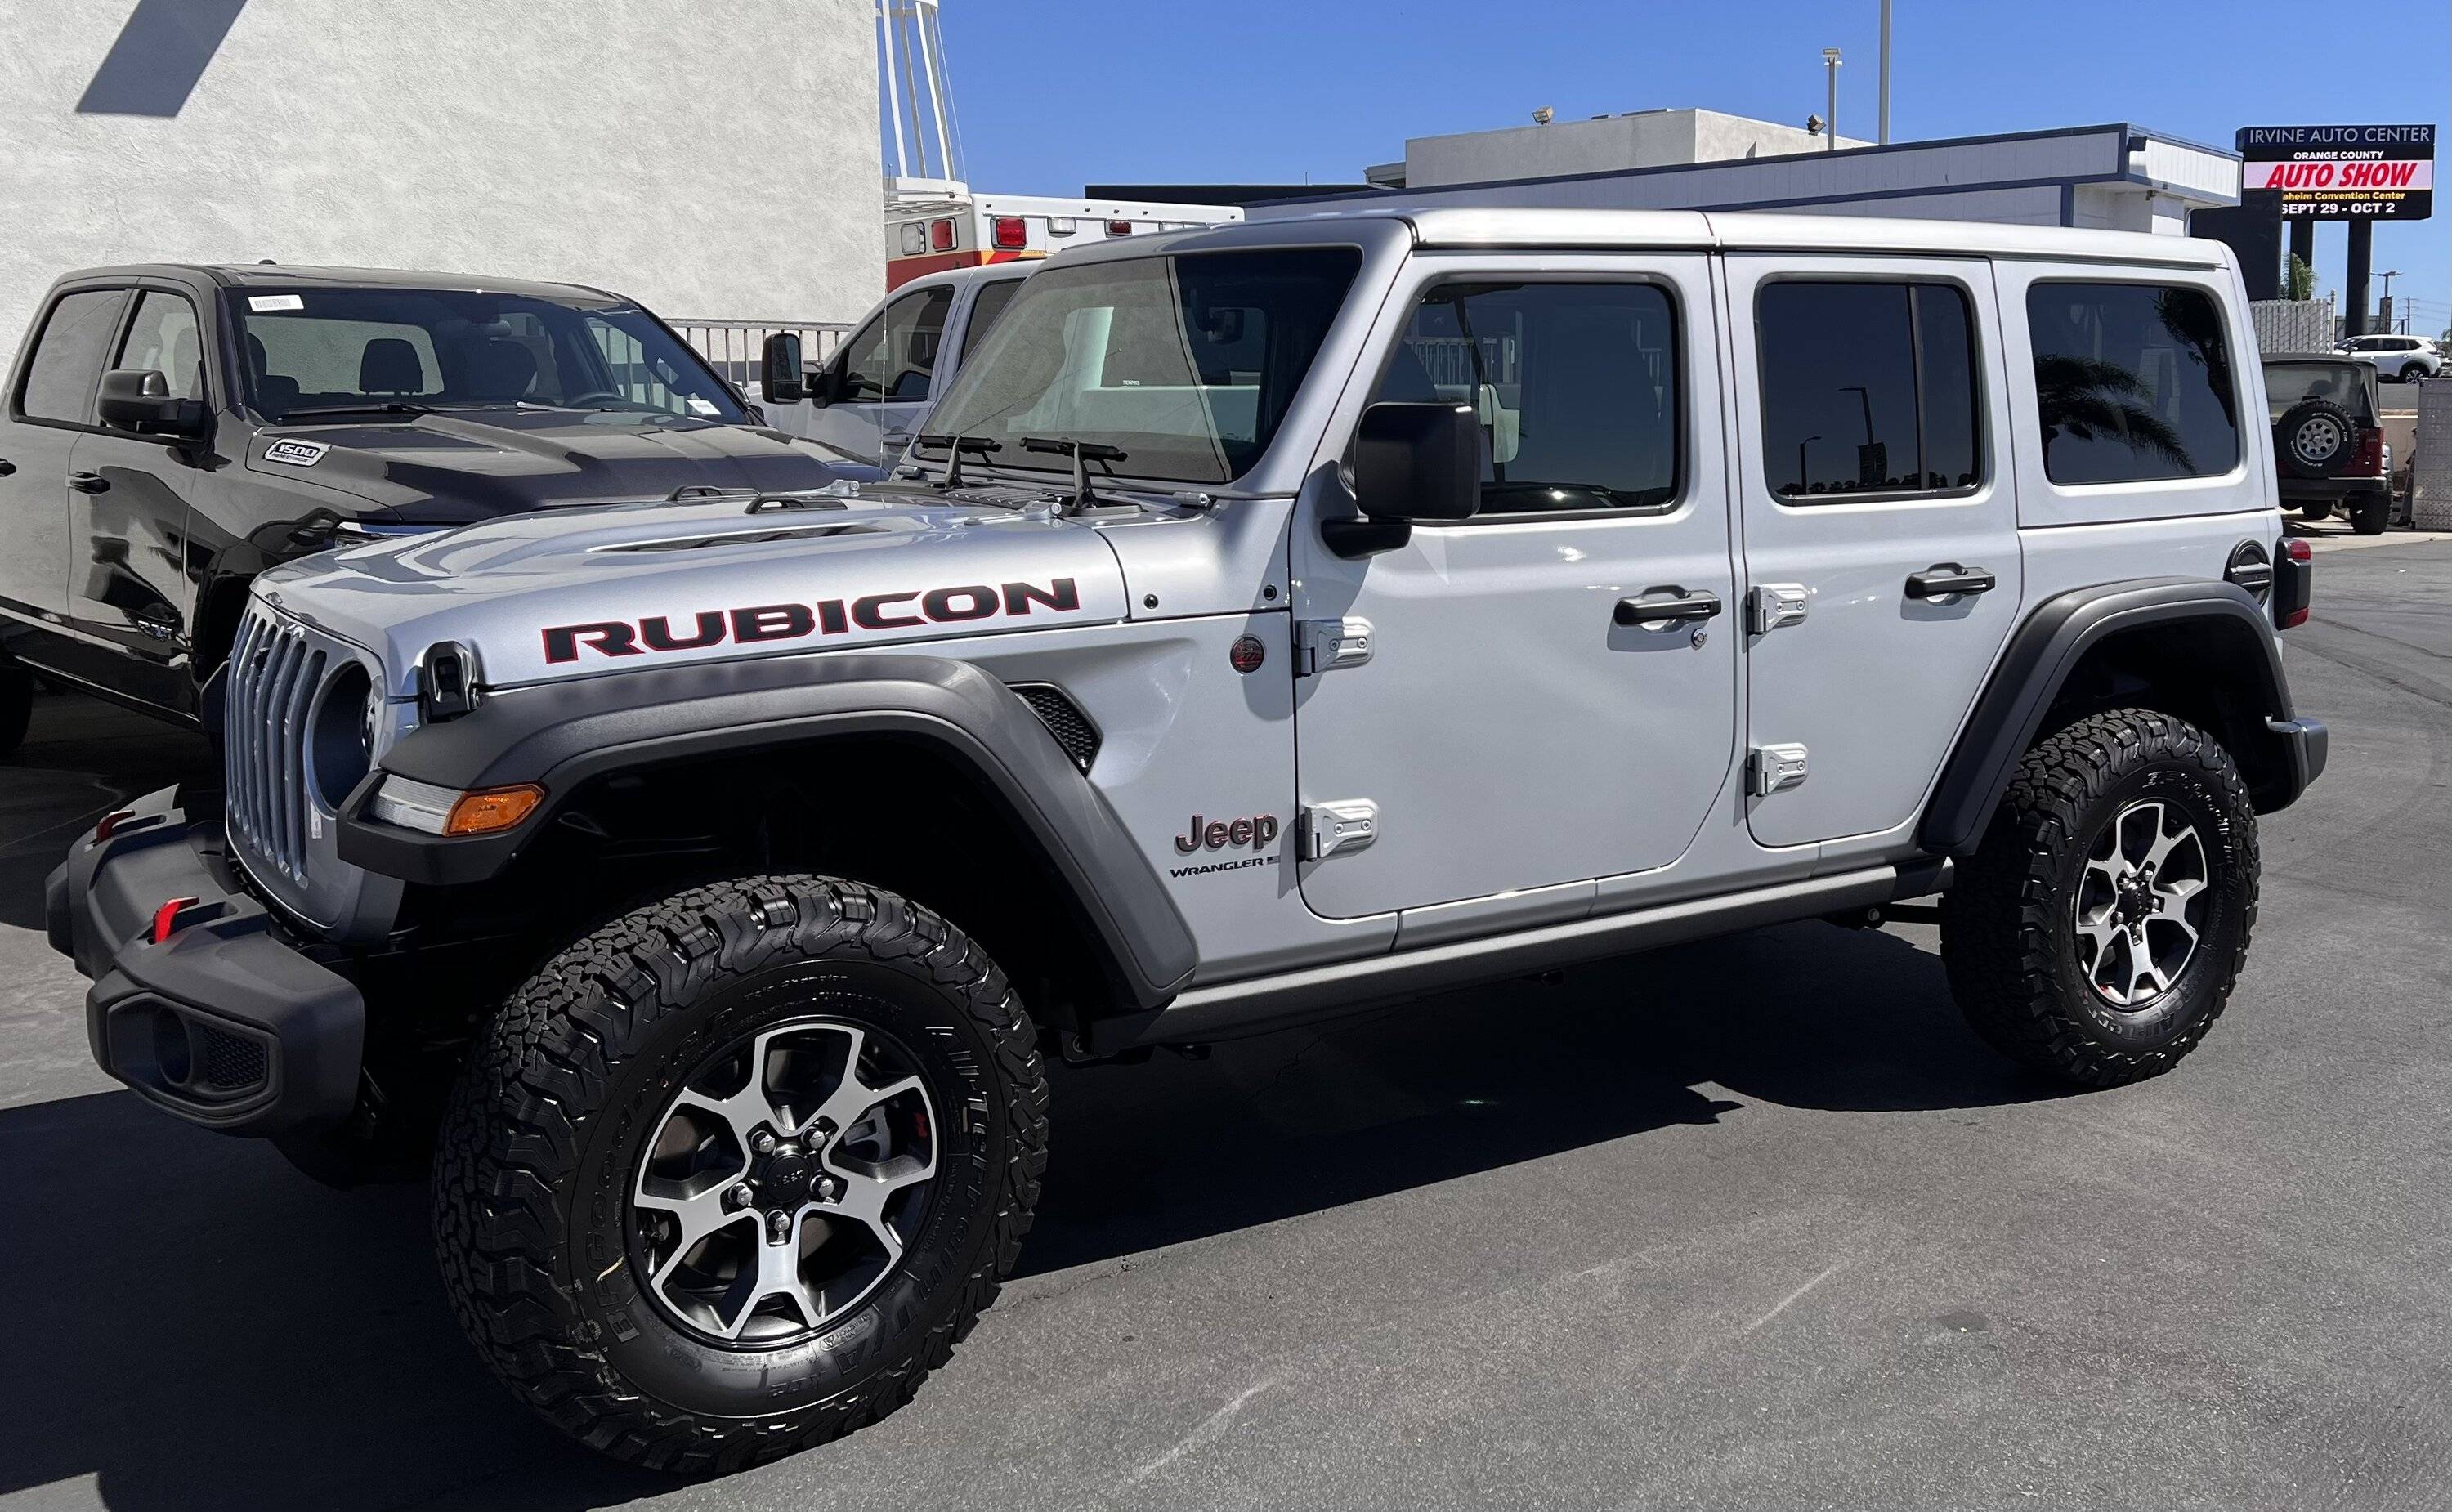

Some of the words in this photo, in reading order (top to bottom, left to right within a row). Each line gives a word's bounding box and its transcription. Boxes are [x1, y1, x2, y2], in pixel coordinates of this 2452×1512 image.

[2249, 128, 2305, 143] IRVINE
[2309, 128, 2359, 143] AUTO
[2365, 127, 2430, 142] CENTER
[2293, 151, 2338, 160] ORANGE
[2340, 150, 2384, 159] COUNTY
[2265, 163, 2334, 189] AUTO
[2338, 163, 2418, 187] SHOW
[2283, 192, 2312, 200] aheim
[2314, 192, 2370, 200] Convention
[2372, 191, 2406, 199] Center
[2282, 203, 2317, 214] SEPT
[2320, 204, 2338, 214] 29
[2351, 203, 2382, 213] OCT
[2385, 202, 2396, 213] 2
[278, 444, 318, 458] 1500
[541, 577, 1080, 664] RUBICON
[1175, 814, 1277, 852] Jeep
[1170, 857, 1264, 878] WRANGLER
